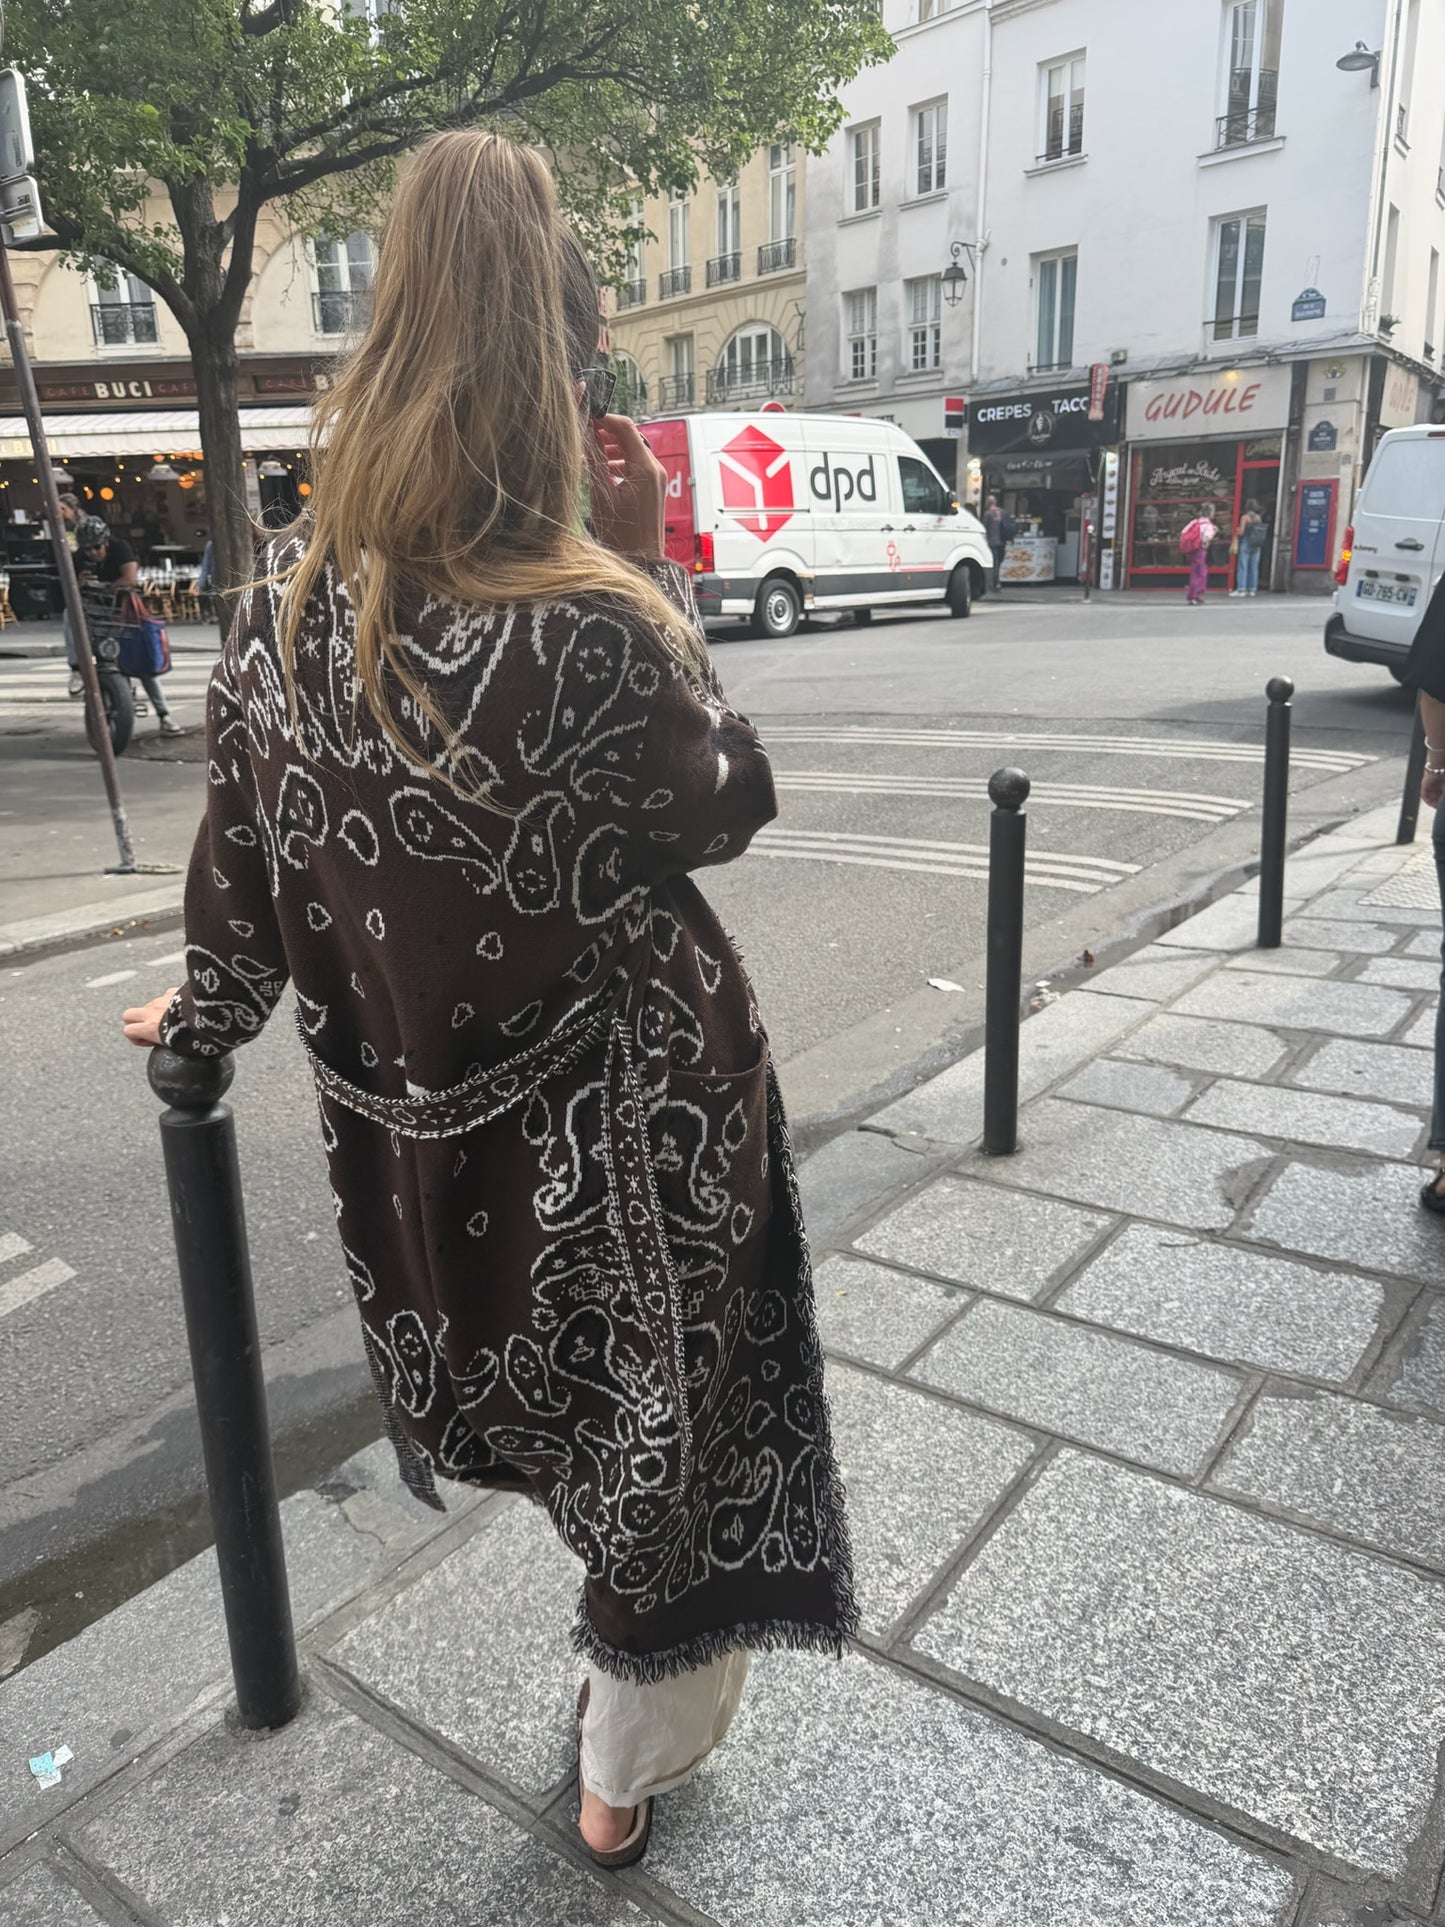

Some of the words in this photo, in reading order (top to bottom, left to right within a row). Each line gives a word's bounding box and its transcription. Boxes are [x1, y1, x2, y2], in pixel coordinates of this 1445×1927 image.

[94, 381, 153, 398] BUCI
[157, 382, 198, 394] CAF
[1145, 383, 1262, 422] GUDULE
[977, 403, 1032, 423] CREPES
[1052, 396, 1090, 414] TACO
[12, 439, 58, 454] BUI
[810, 451, 877, 513] dpd
